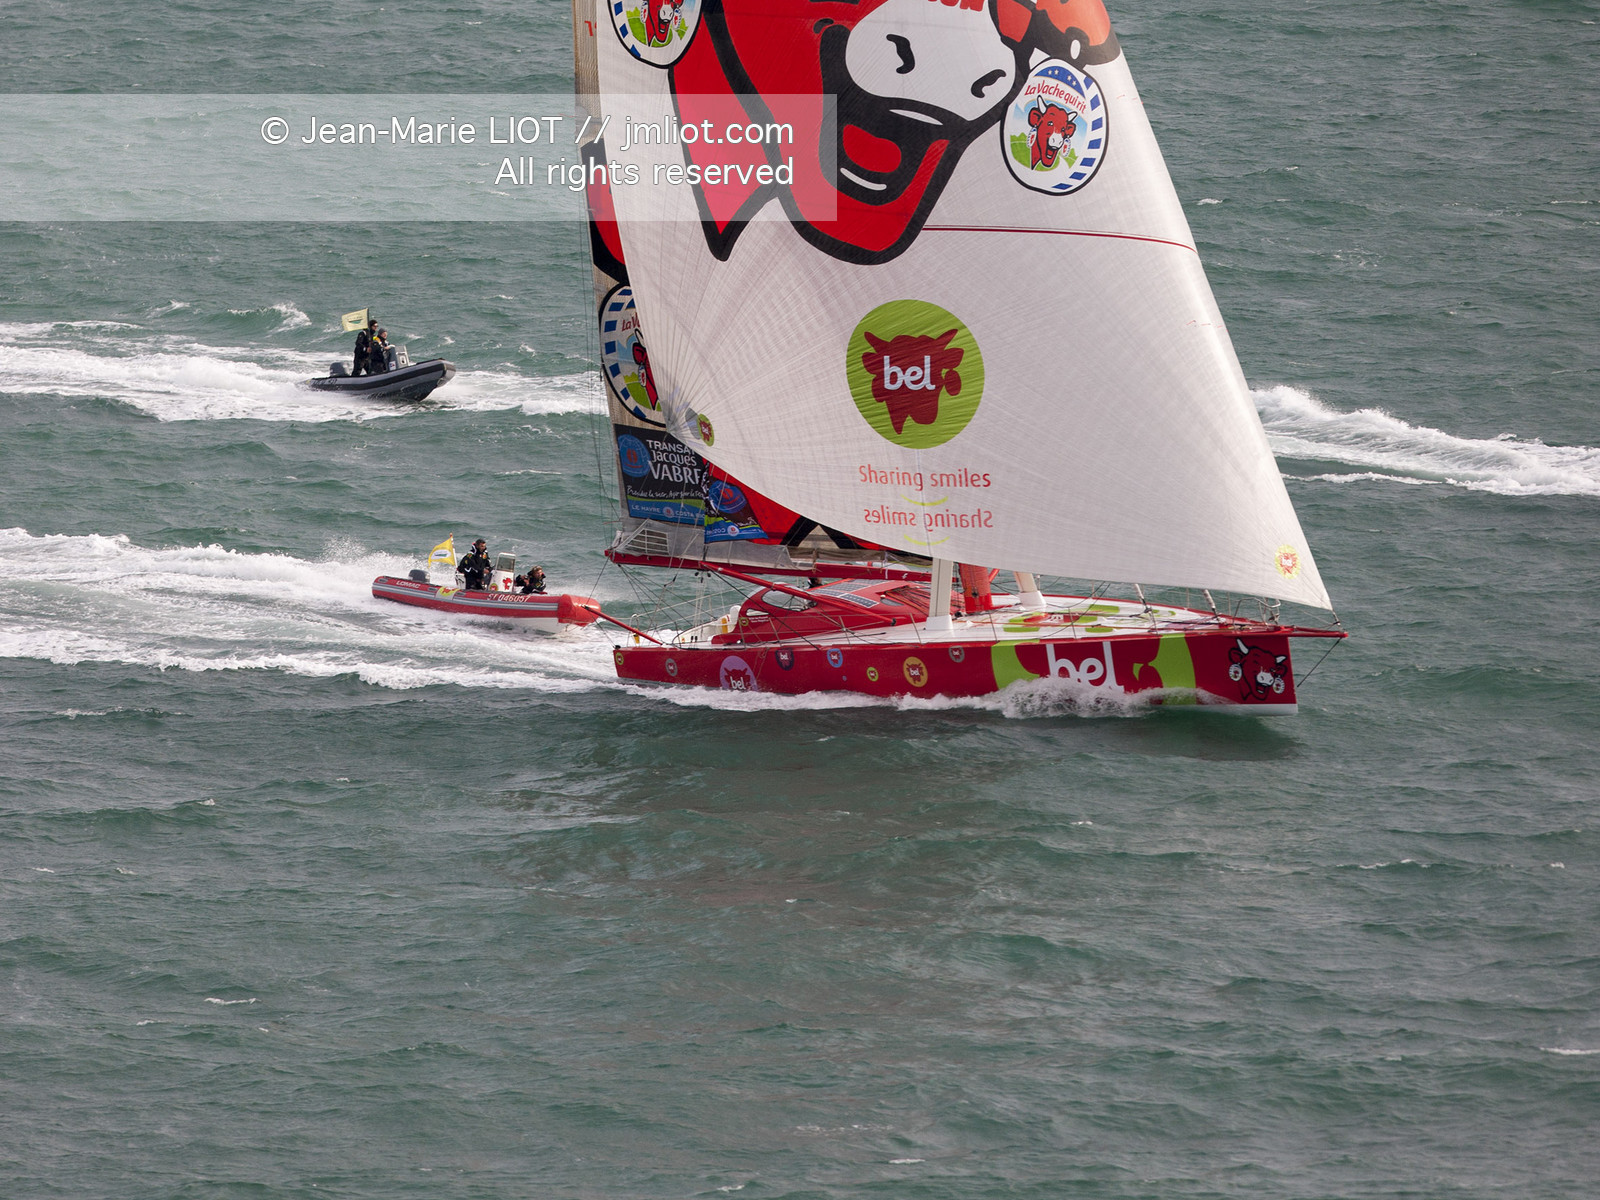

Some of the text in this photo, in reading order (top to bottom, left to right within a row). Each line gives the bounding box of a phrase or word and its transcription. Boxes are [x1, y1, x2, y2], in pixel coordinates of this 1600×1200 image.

[1024, 80, 1087, 114] La Vache qui rit
[884, 356, 935, 390] bel
[651, 450, 697, 467] Jacques
[859, 464, 991, 491] Sharing smiles
[396, 580, 421, 589] LOMAC
[1046, 641, 1124, 693] bel
[730, 676, 746, 690] bel
